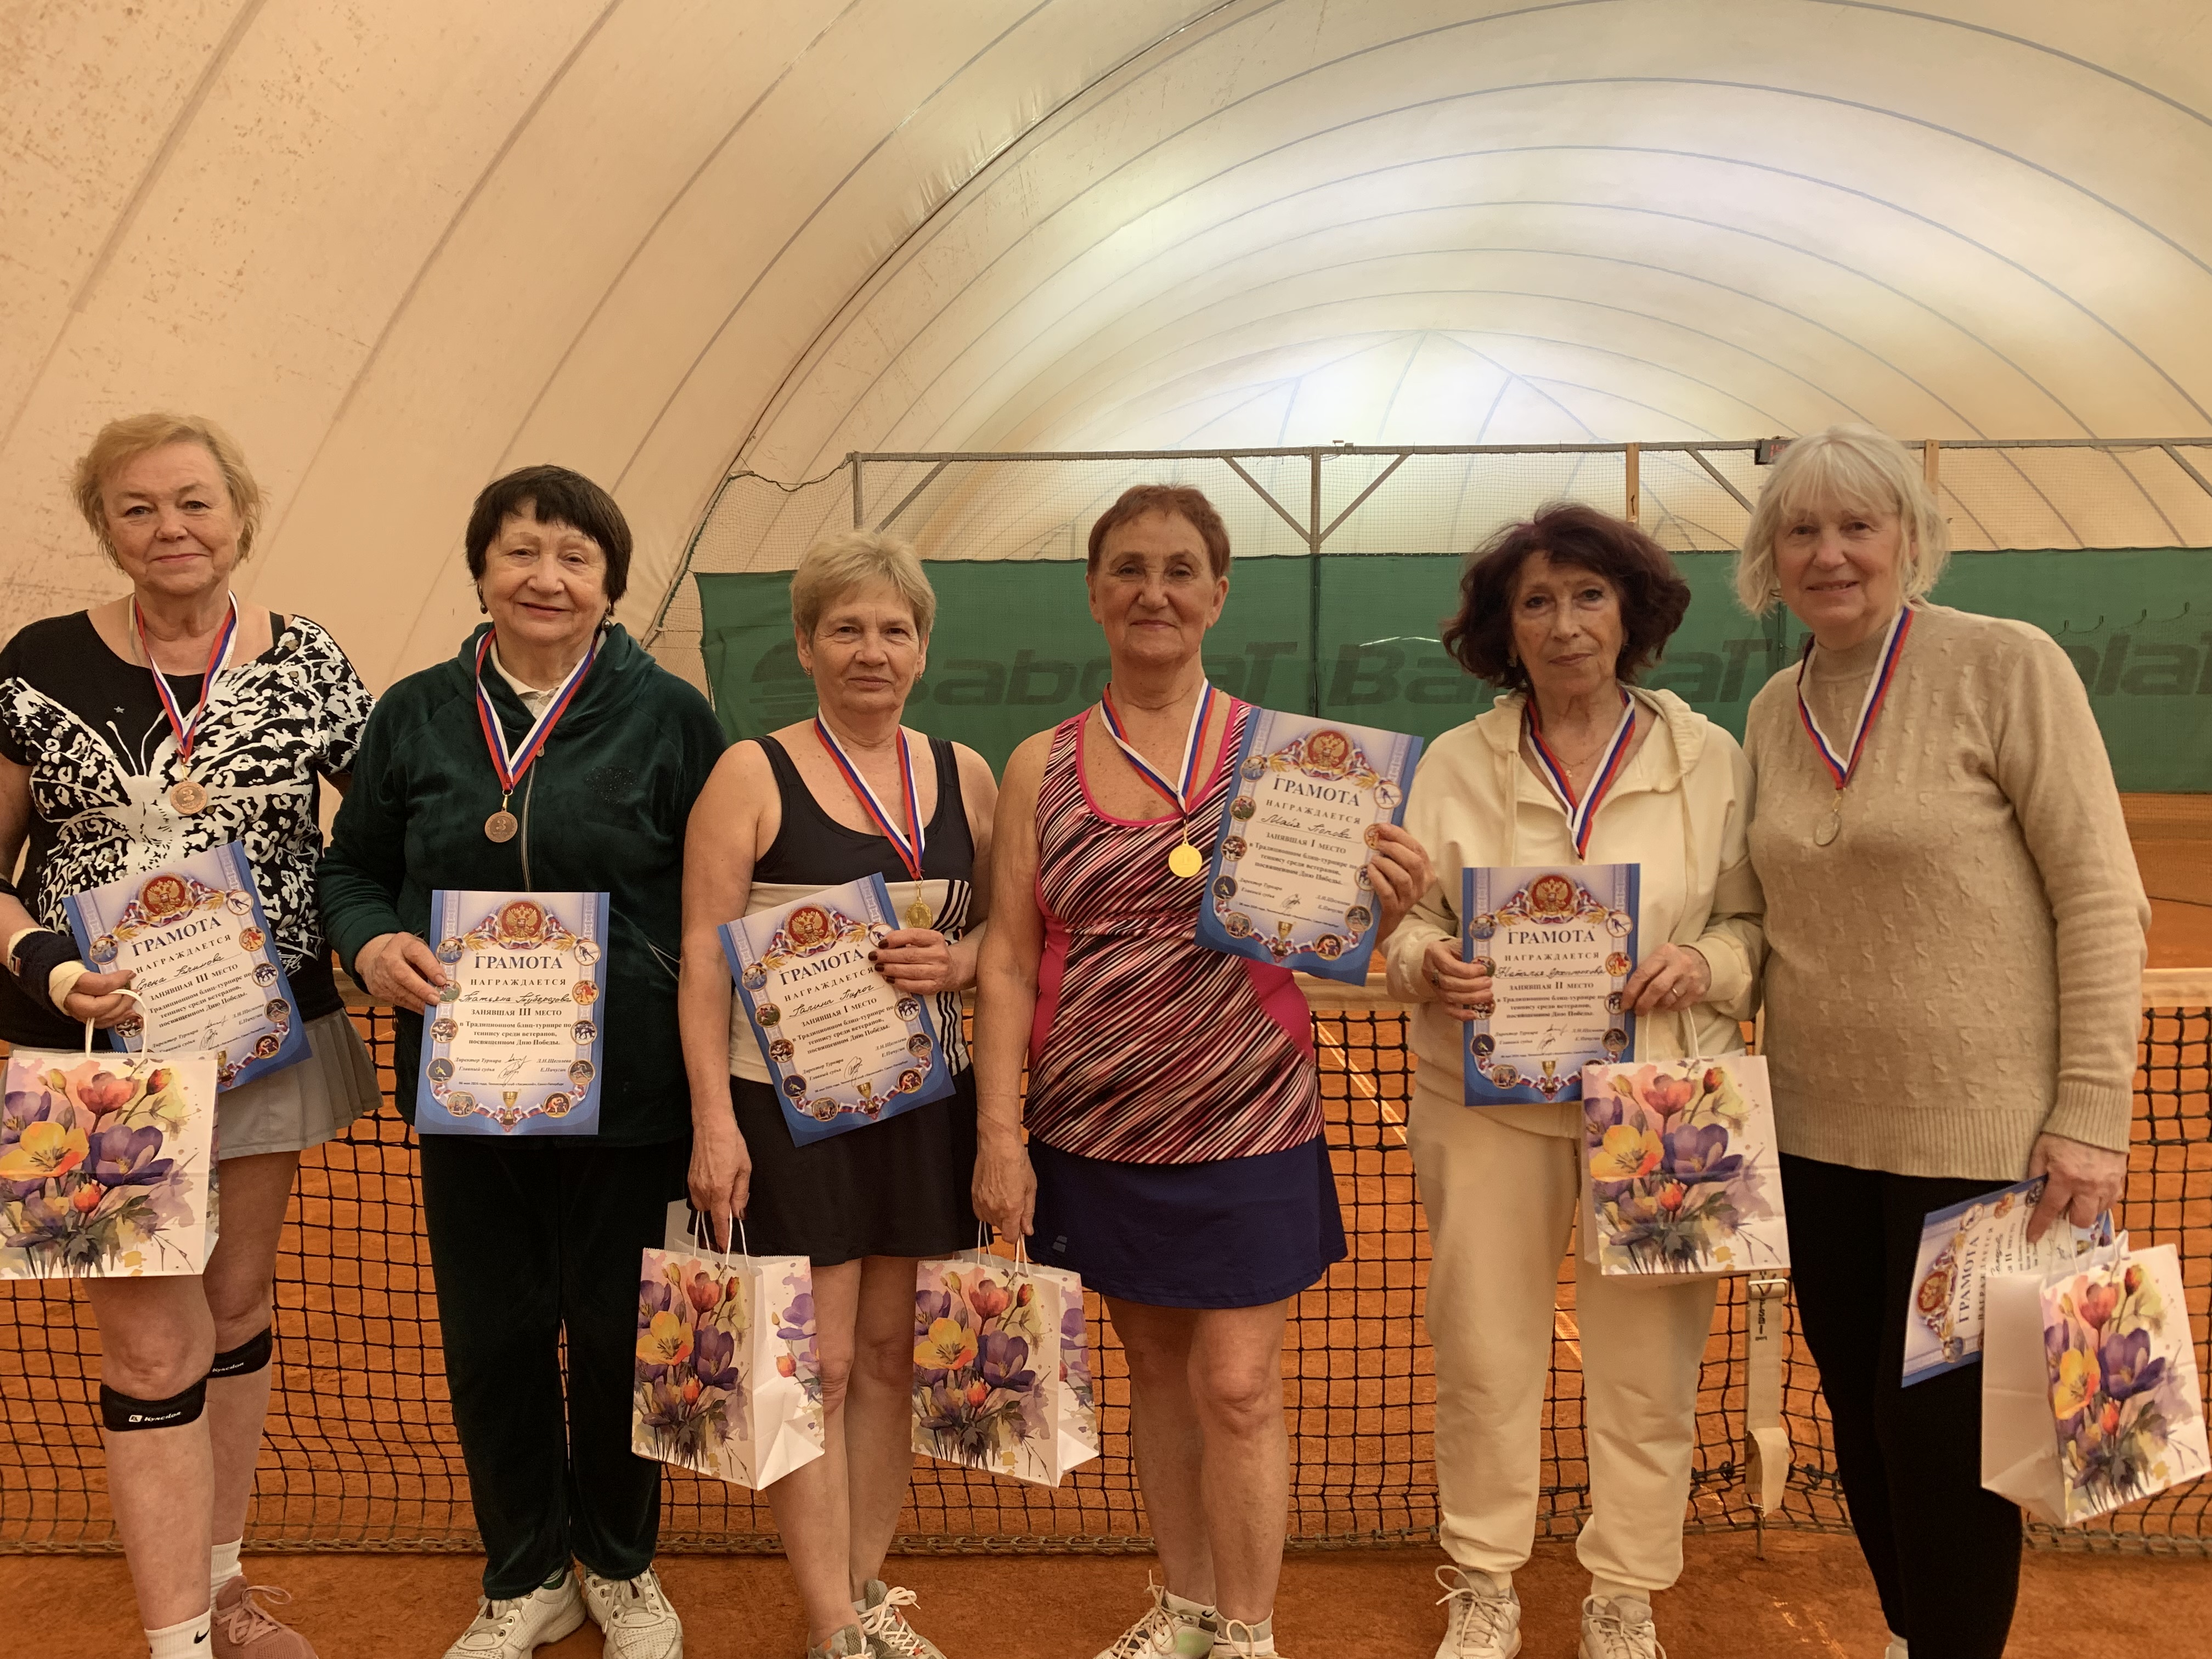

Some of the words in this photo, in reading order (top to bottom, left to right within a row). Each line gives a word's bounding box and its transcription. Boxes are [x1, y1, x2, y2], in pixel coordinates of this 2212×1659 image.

[1327, 638, 1773, 706] BaaT
[183, 789, 195, 801] 3
[1273, 777, 1359, 806] ГРАМОТА
[1266, 799, 1361, 825] НАГРАЖДАЕТСЯ
[496, 819, 506, 831] 3
[1261, 814, 1300, 828] Майя
[1307, 823, 1352, 839] Попова
[1311, 839, 1316, 848] I
[132, 916, 222, 957] ГРАМОТА
[1508, 929, 1595, 944] ГРАМОТА
[136, 934, 231, 974] НАГРАЖДАЕТСЯ
[475, 956, 563, 969] ГРАМОТА
[1505, 952, 1599, 961] НАГРАЖДАЕТСЯ
[780, 949, 864, 985] ГРАМОТА
[136, 977, 167, 991] Елена
[150, 980, 193, 1001] ЗАНЯВШАЯ
[195, 973, 208, 984] III
[211, 964, 238, 977] МЕСТО
[784, 967, 873, 1002] НАГРАЖДАЕТСЯ
[149, 992, 199, 1013] Традиционном
[188, 998, 207, 1008] среди
[459, 991, 511, 1003] Татьяна
[789, 999, 834, 1018] Галина
[839, 985, 874, 1001] Пирог
[519, 1008, 531, 1016] III
[802, 1009, 842, 1027] ЗАНЯВШАЯ
[844, 1005, 848, 1013] I
[851, 998, 877, 1009] МЕСТО
[1959, 1236, 1979, 1323] ГРАМОТА
